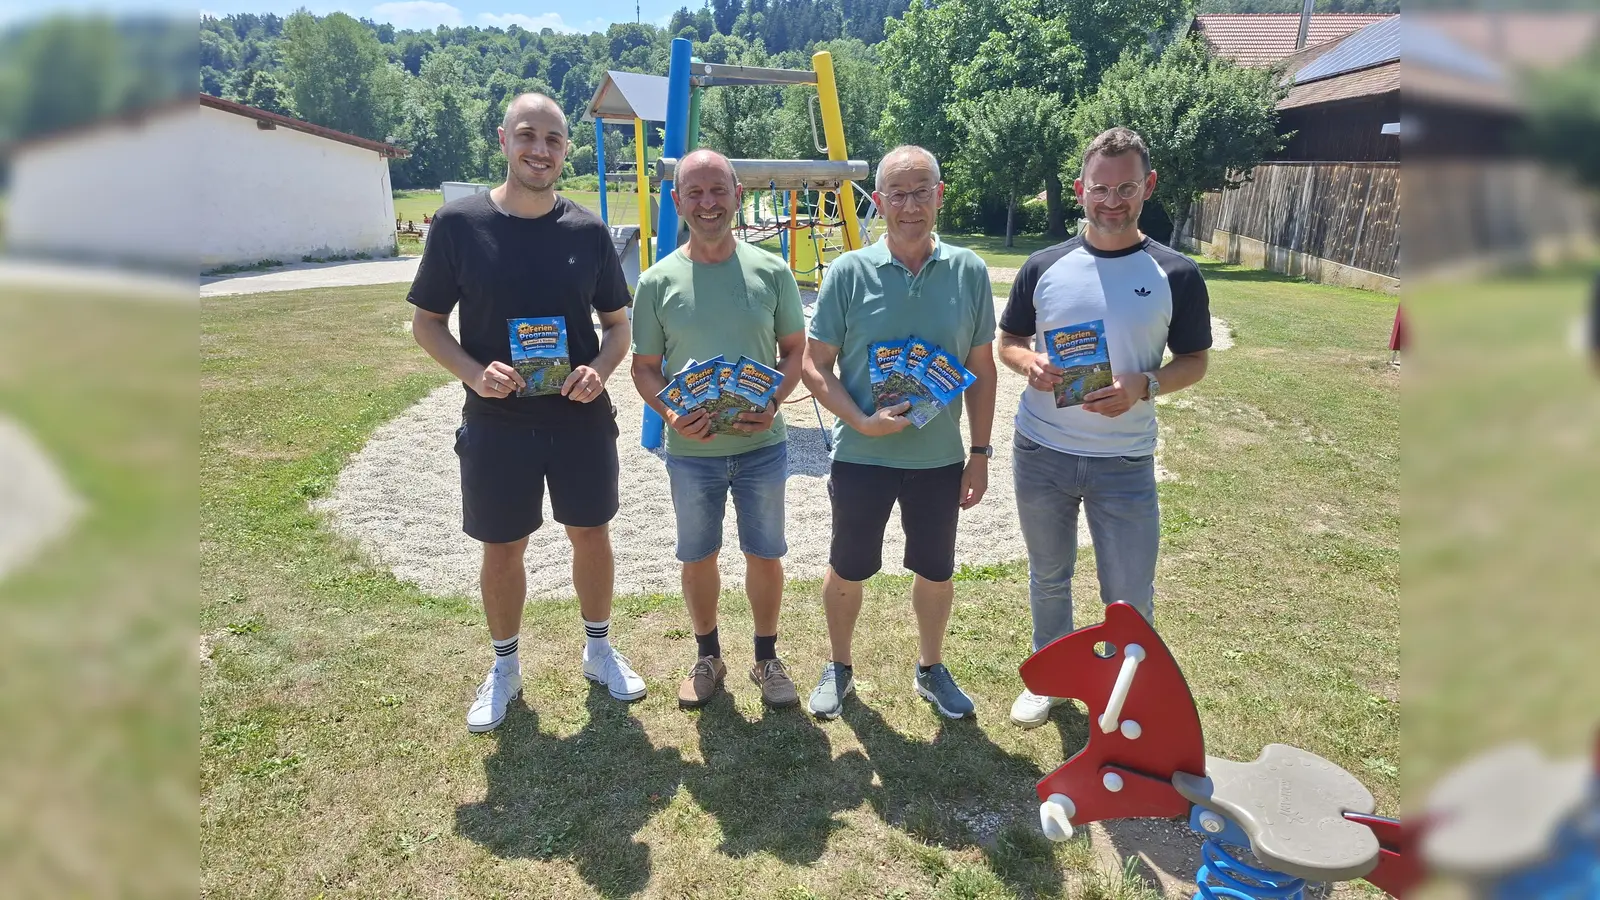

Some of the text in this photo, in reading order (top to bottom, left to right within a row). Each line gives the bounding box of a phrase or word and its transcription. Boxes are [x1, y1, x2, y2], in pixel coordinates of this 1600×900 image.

[530, 325, 553, 333] Ferien
[1067, 331, 1091, 341] Ferien
[1056, 337, 1097, 350] Programm
[751, 370, 771, 382] Ferien
[931, 361, 960, 387] Programm
[943, 363, 961, 380] Ferien
[687, 375, 713, 390] Progra
[741, 372, 771, 388] Programm
